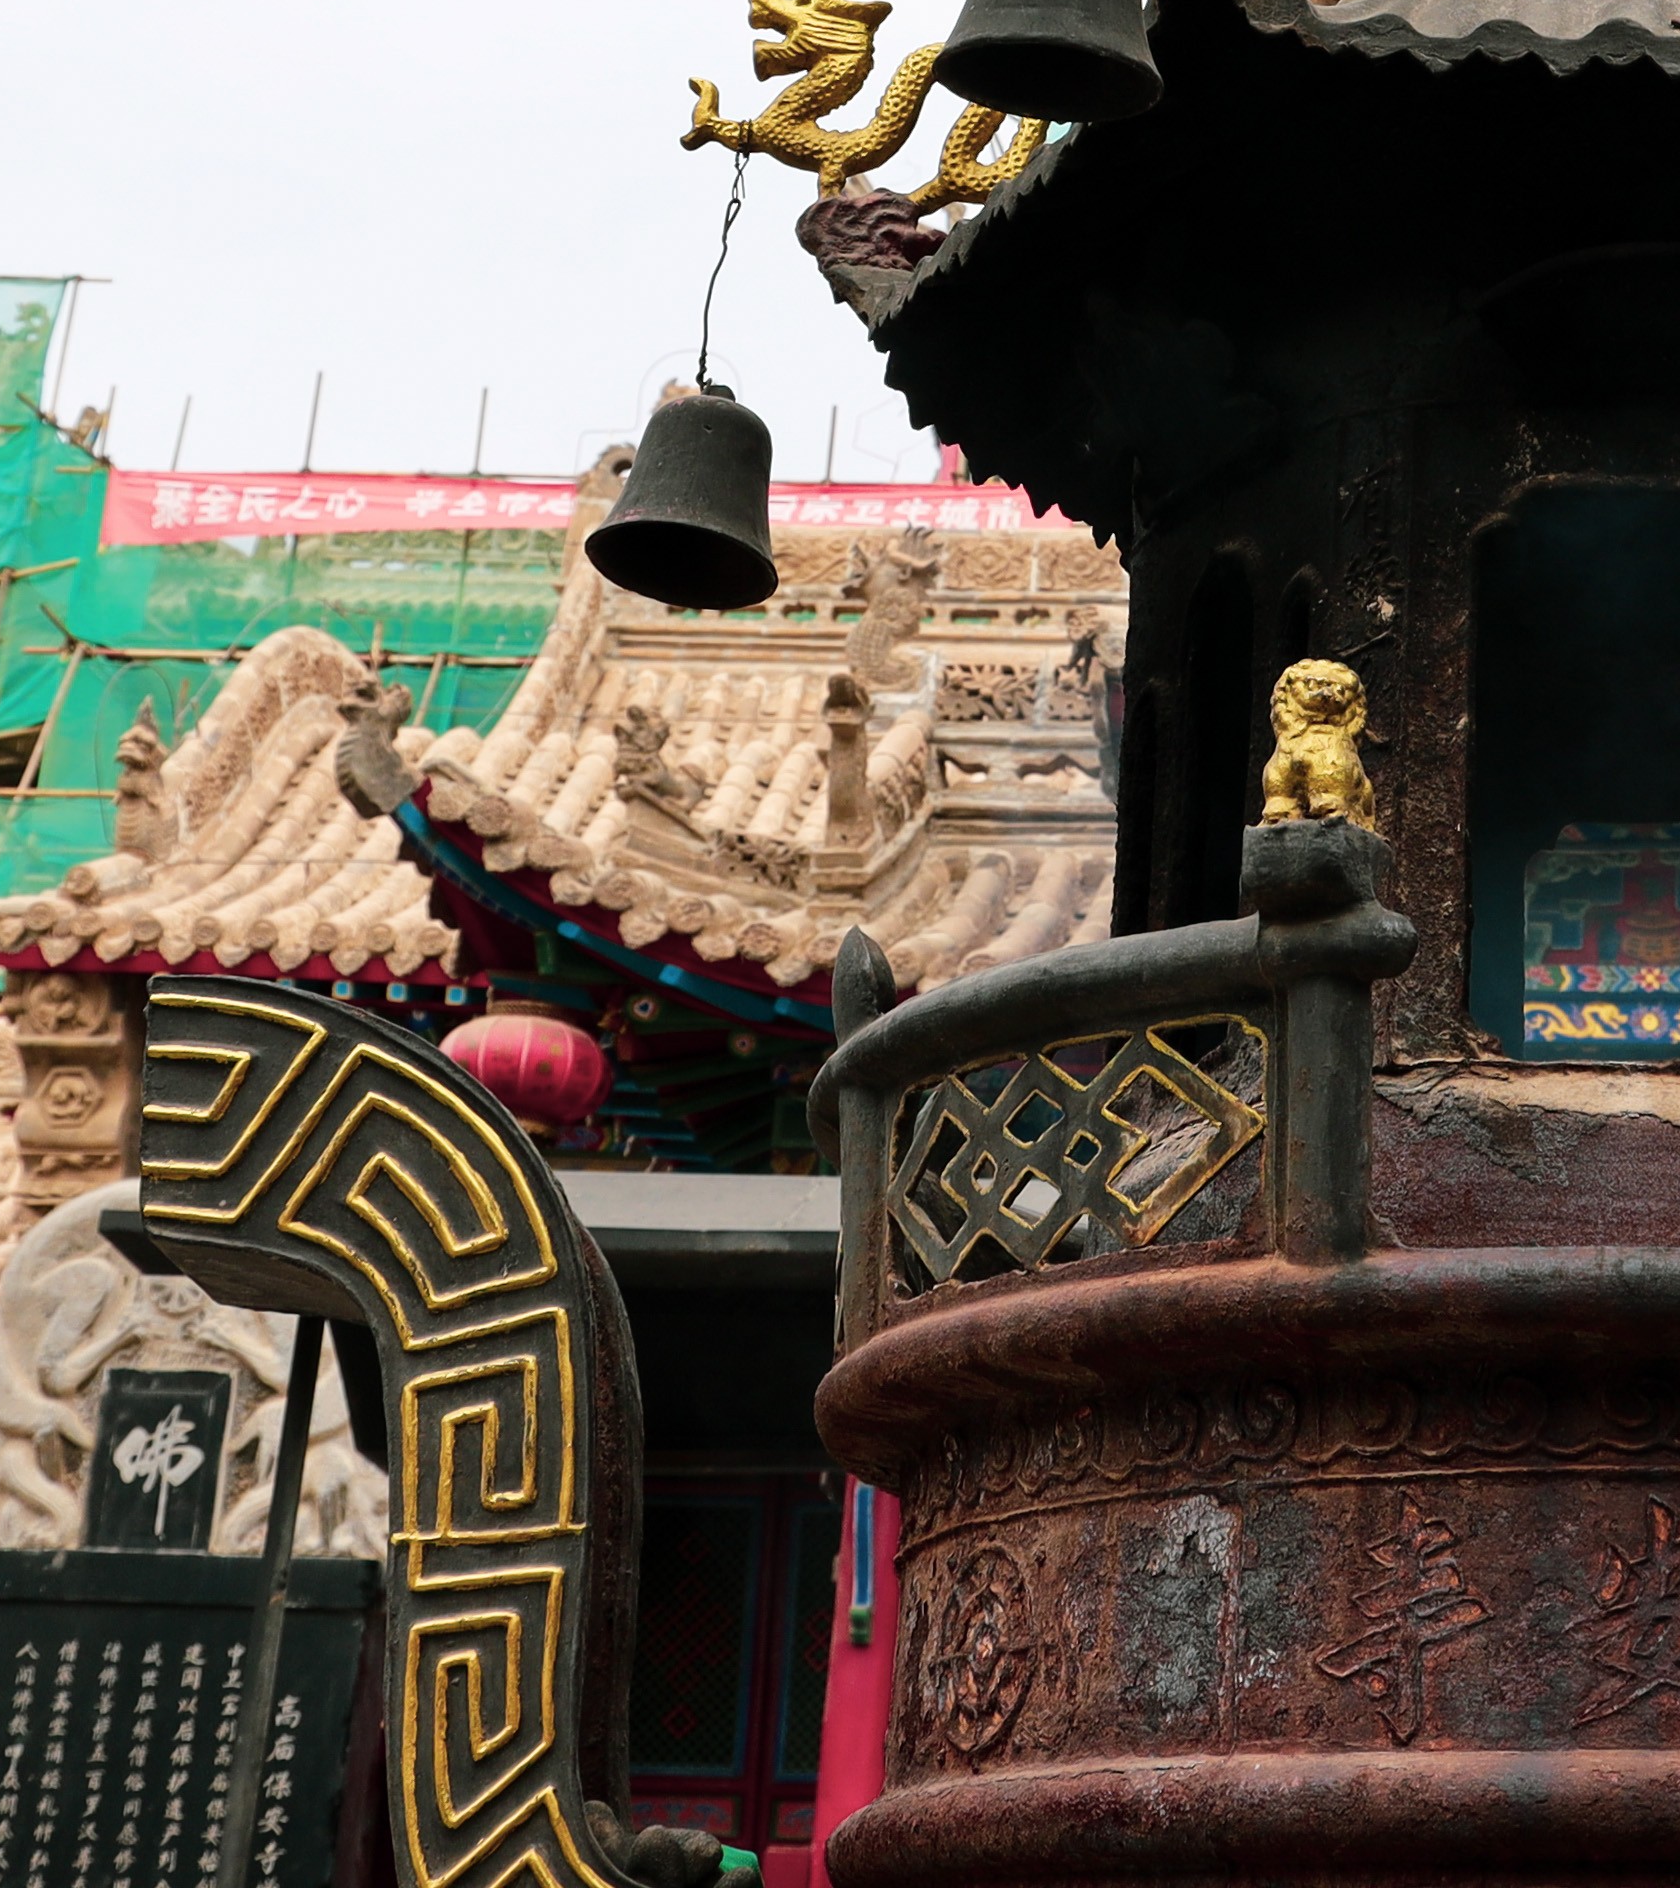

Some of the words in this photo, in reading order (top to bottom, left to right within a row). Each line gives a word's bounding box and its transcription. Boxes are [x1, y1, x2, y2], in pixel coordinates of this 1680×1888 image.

[151, 480, 368, 529] 聚全民之心
